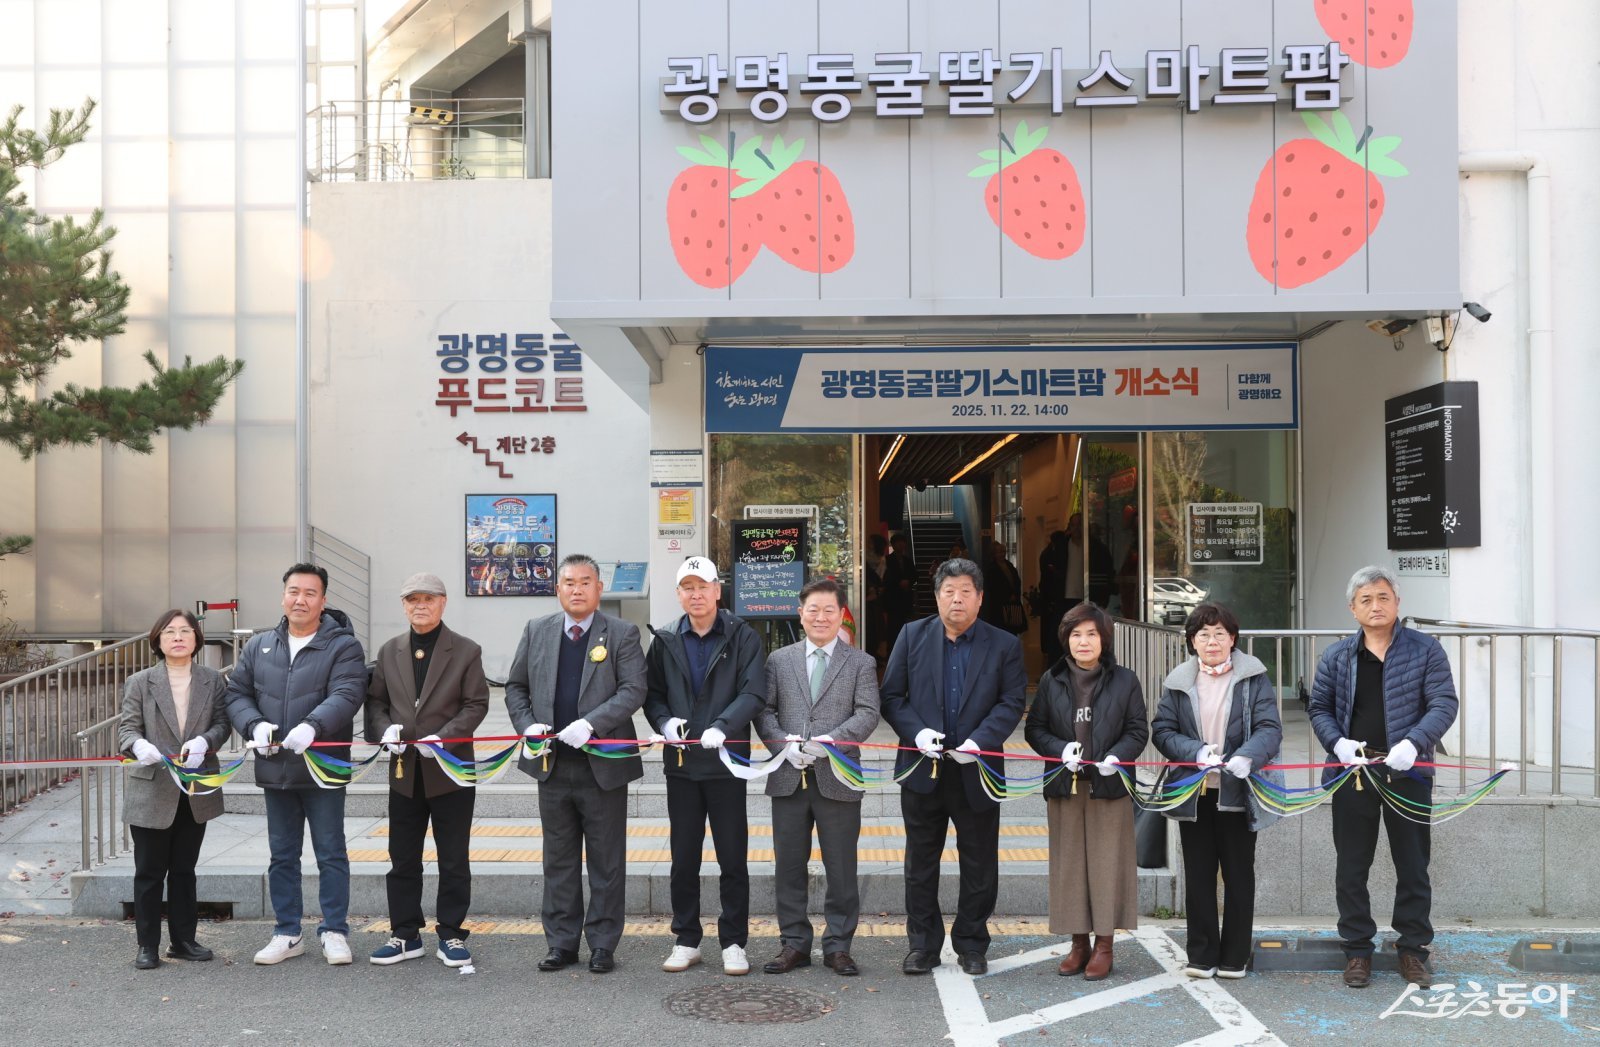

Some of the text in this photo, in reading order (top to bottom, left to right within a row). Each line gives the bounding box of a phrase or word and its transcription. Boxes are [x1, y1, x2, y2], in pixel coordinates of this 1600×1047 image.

[663, 41, 1351, 123] 광명동굴딸기스마트팜
[436, 333, 584, 374] 광명동굴
[715, 371, 785, 388] 함께하는 시민
[821, 367, 1200, 399] 광명동굴딸기스마트팜 개소식
[1237, 372, 1272, 385] 다함께
[435, 377, 588, 417] 푸드코트
[724, 392, 778, 408] 웃는 광명
[1237, 388, 1282, 400] 광명해요
[951, 404, 1069, 417] 2025. 11. 22. 14:00
[496, 436, 557, 455] 계단 2층
[687, 559, 700, 570] NY
